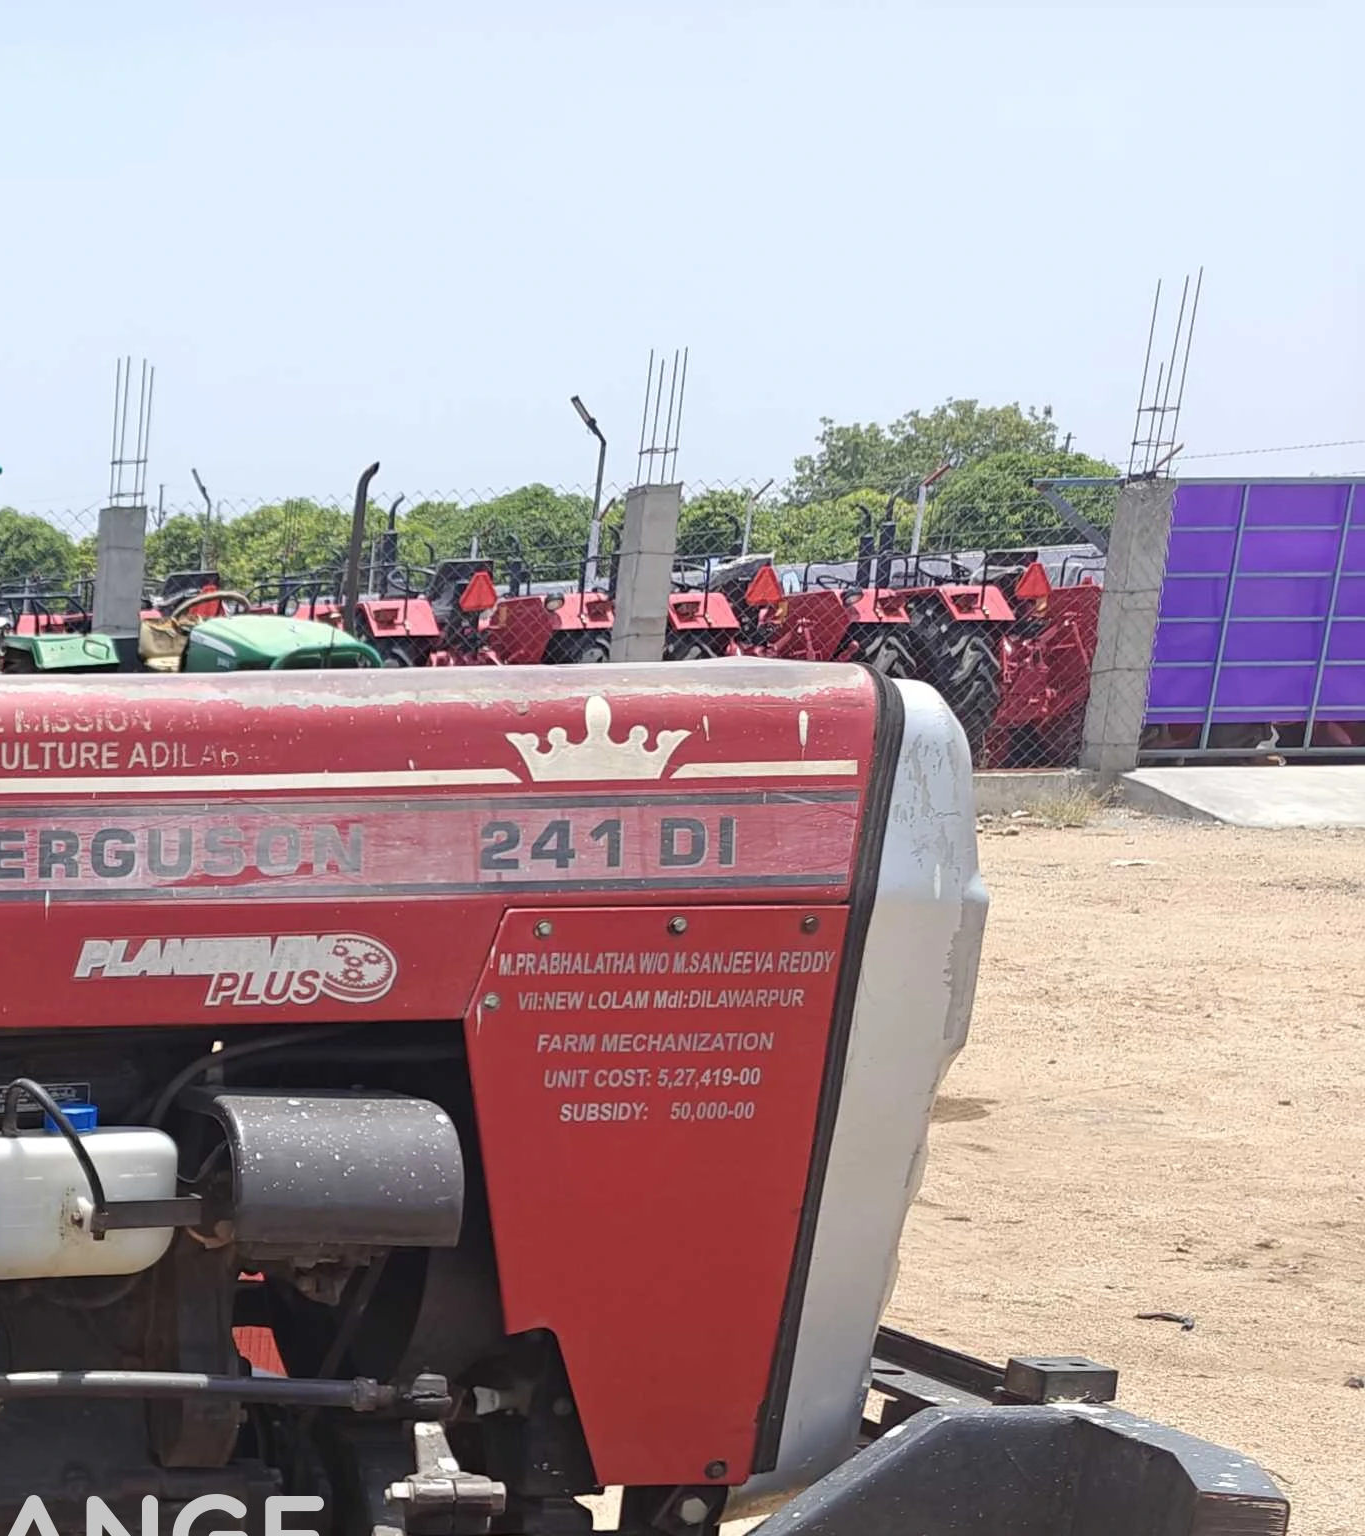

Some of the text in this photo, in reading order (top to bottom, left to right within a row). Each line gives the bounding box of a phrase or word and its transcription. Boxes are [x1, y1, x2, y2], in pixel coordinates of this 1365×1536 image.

[480, 816, 735, 869] 241 DI
[499, 950, 836, 976] M.PRABHALATHA W/O M.SANJEEVA REDDY
[205, 970, 320, 1006] PLUS
[588, 990, 649, 1009] LOLAM
[537, 1031, 775, 1053] FARM MECHANIZATION
[544, 1067, 762, 1090] UNIT COST: 5,27,419-00
[559, 1101, 755, 1122] SUBSIDY: 50,000-00
